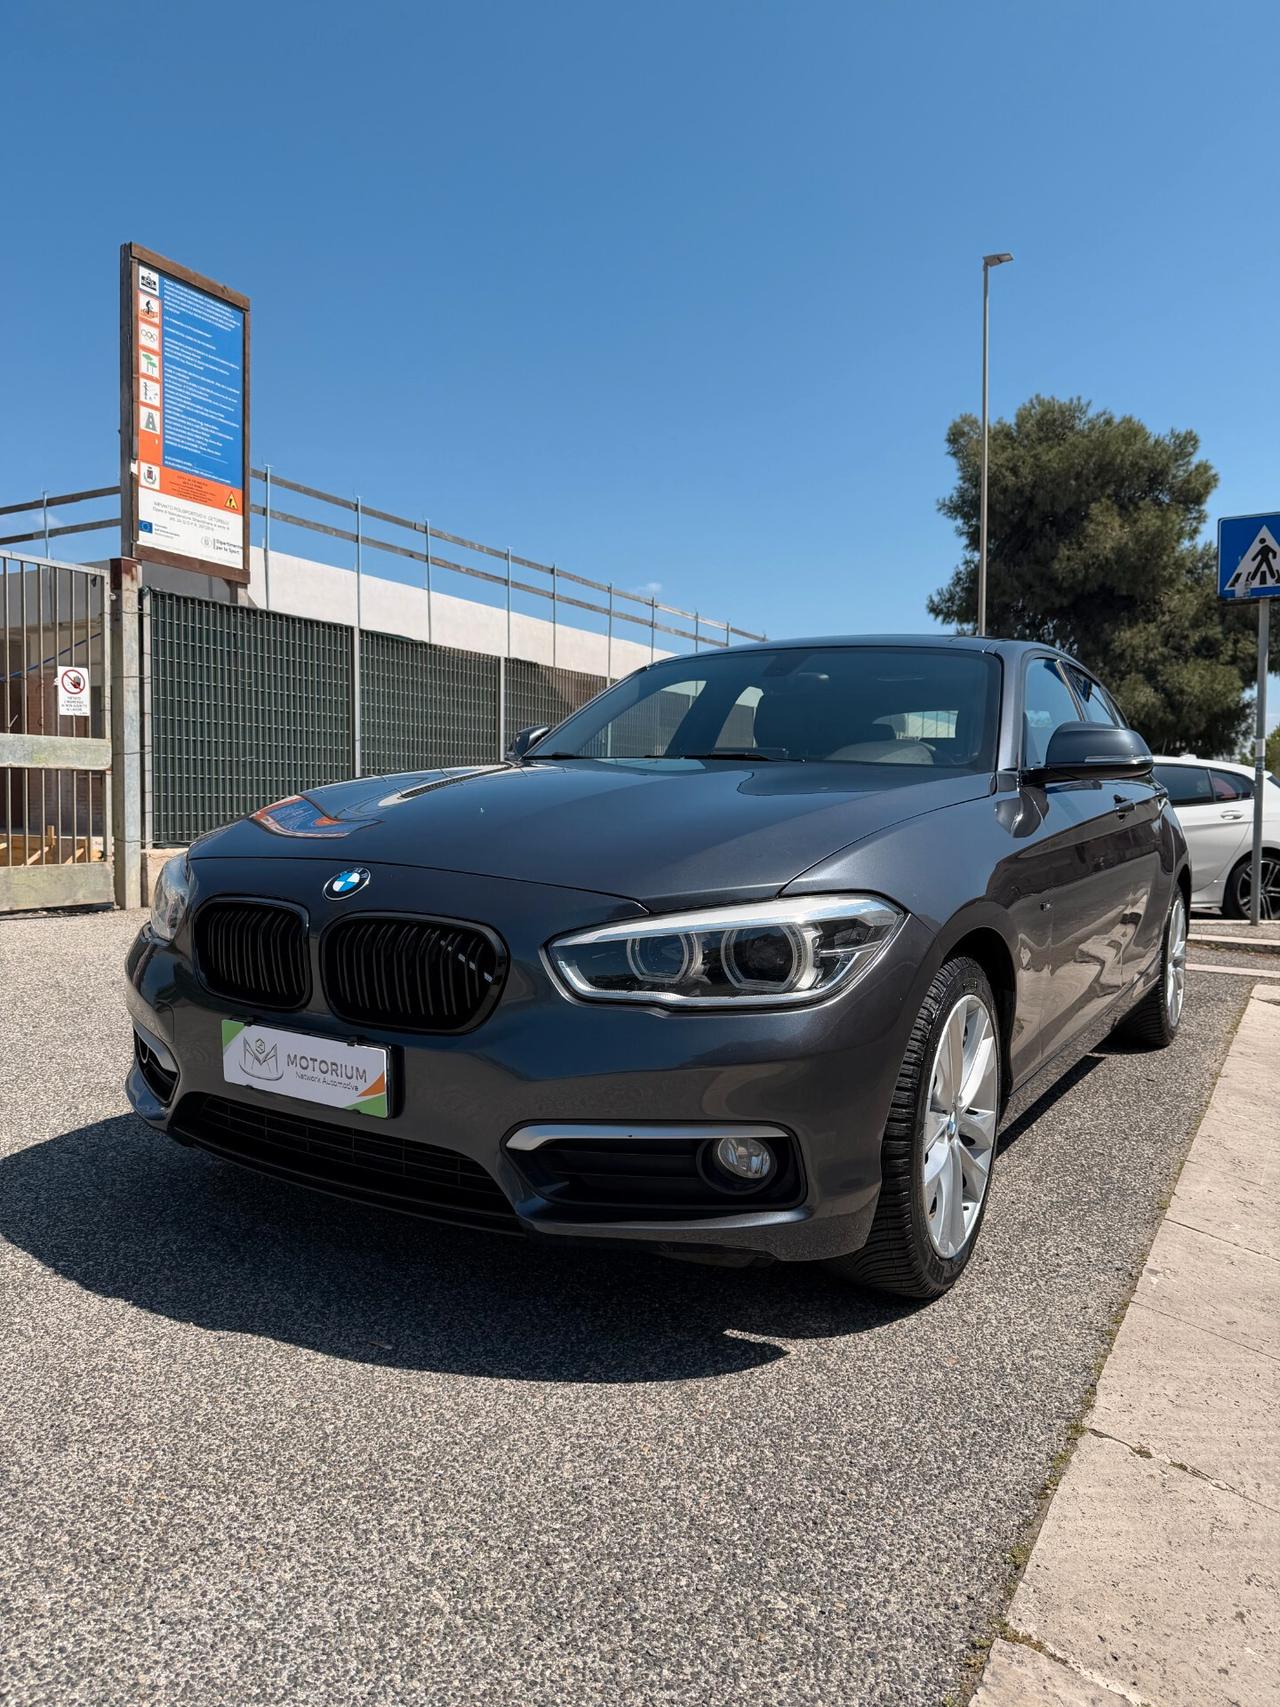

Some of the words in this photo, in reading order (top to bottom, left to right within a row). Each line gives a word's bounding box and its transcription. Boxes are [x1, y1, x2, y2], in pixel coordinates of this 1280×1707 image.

[287, 1053, 367, 1083] MOTORIUM
[295, 1071, 322, 1084] Network
[322, 1077, 359, 1092] Automotive
